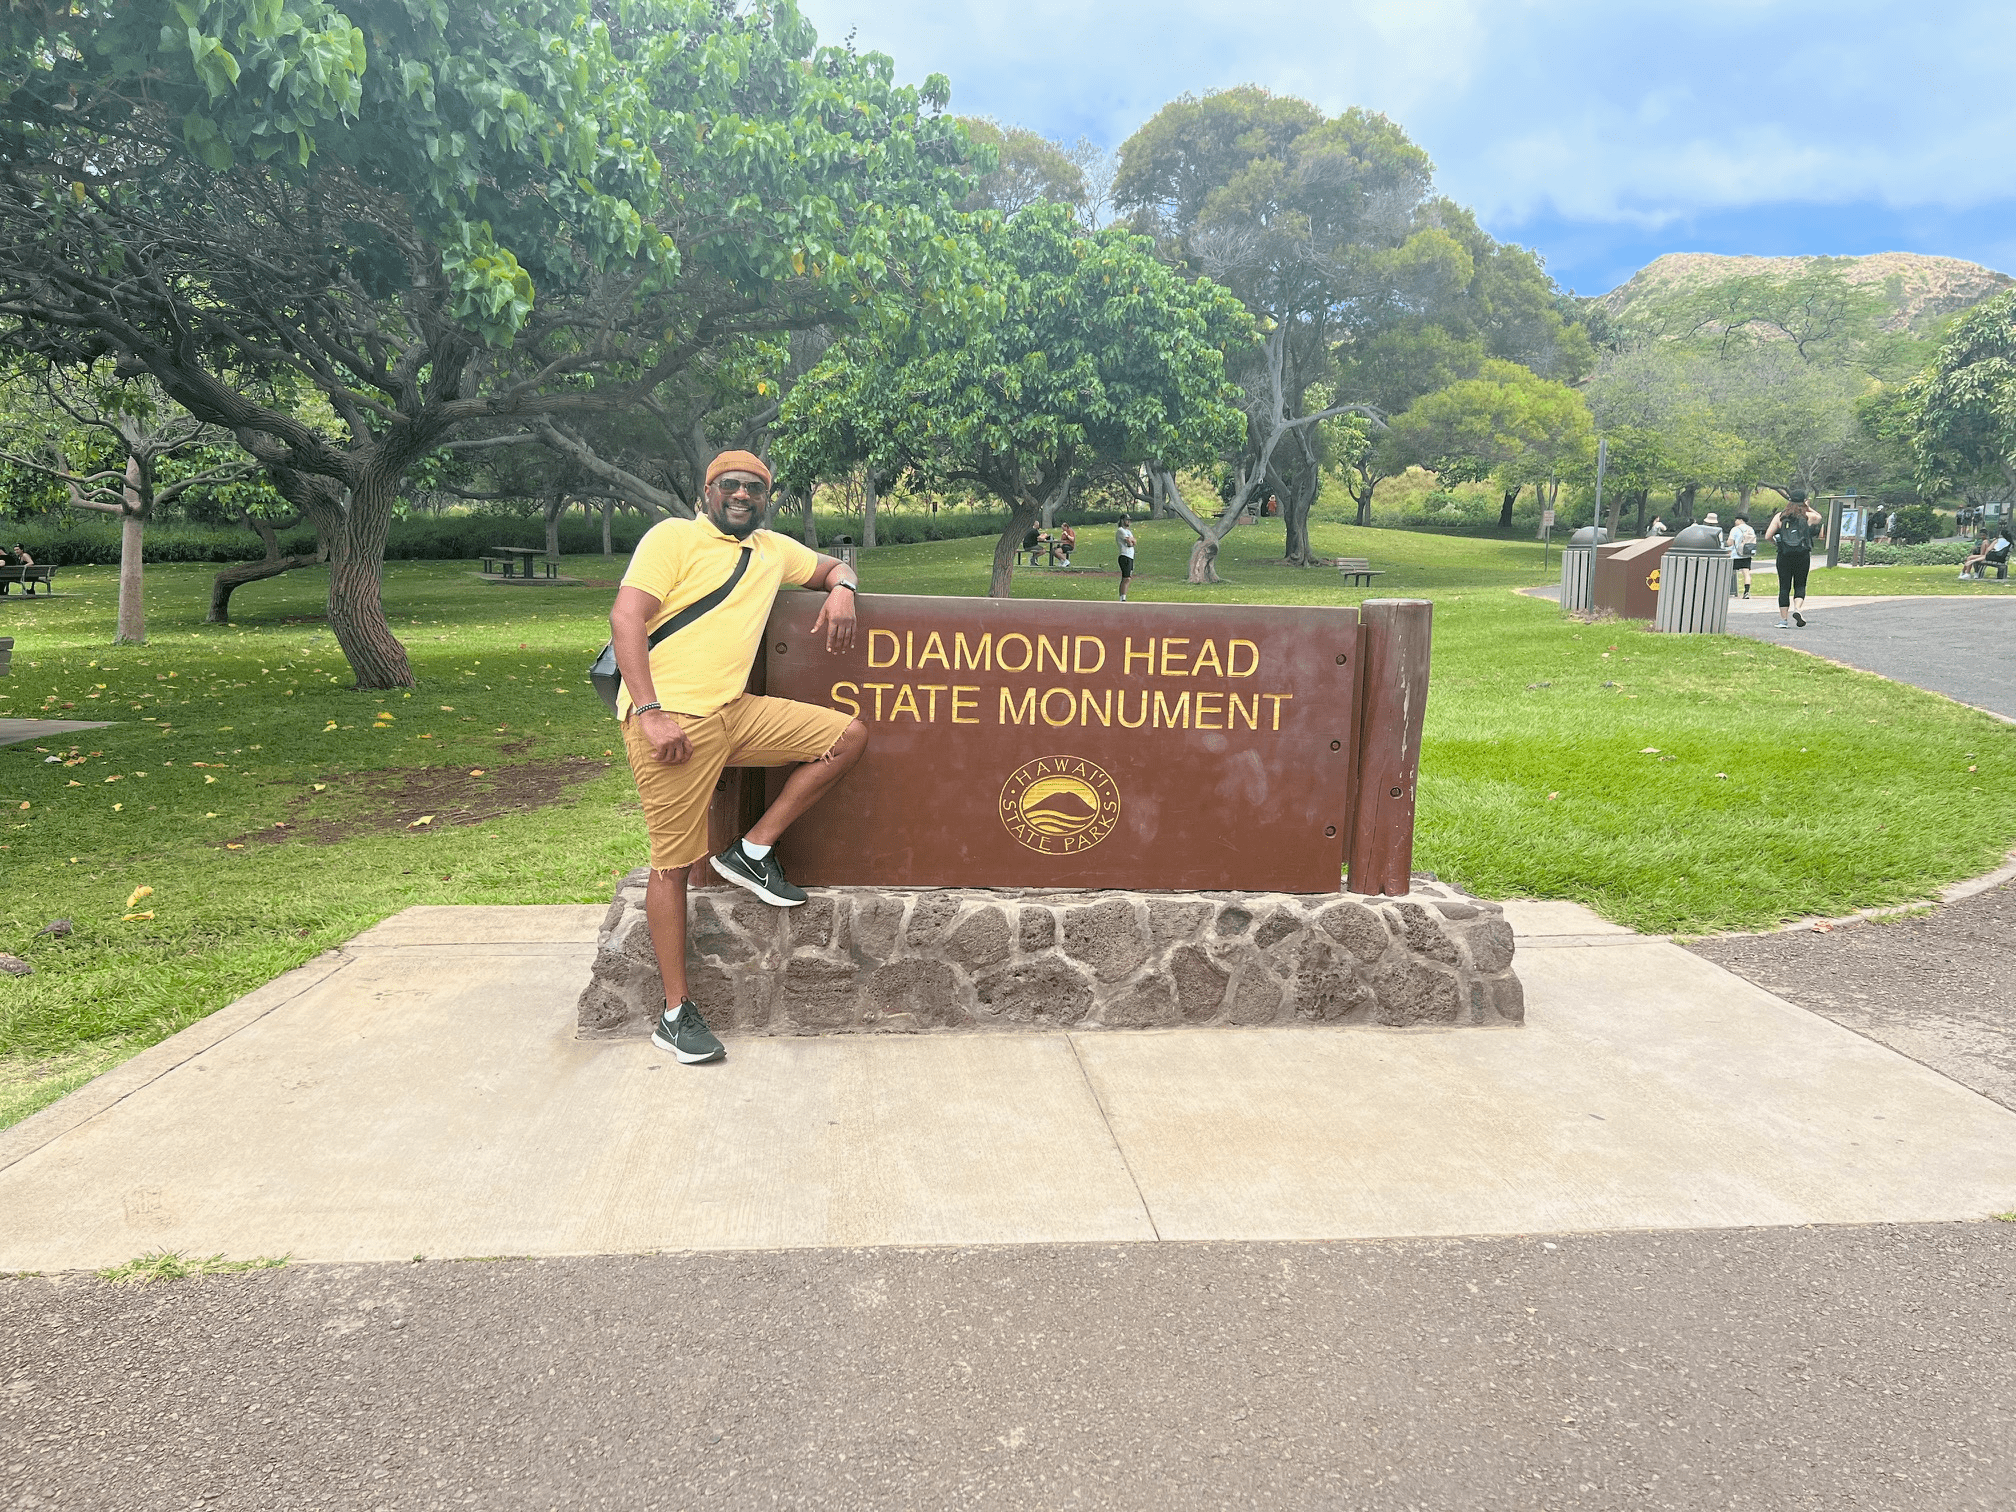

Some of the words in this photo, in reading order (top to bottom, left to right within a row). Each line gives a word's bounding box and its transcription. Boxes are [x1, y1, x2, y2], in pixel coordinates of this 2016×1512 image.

[867, 628, 1106, 674] DIAMOND
[1123, 636, 1260, 678] HEAD
[830, 680, 981, 724] STATE
[998, 686, 1294, 731] MONUMENT
[1002, 798, 1052, 851] STATE
[1064, 801, 1117, 851] PARKS
